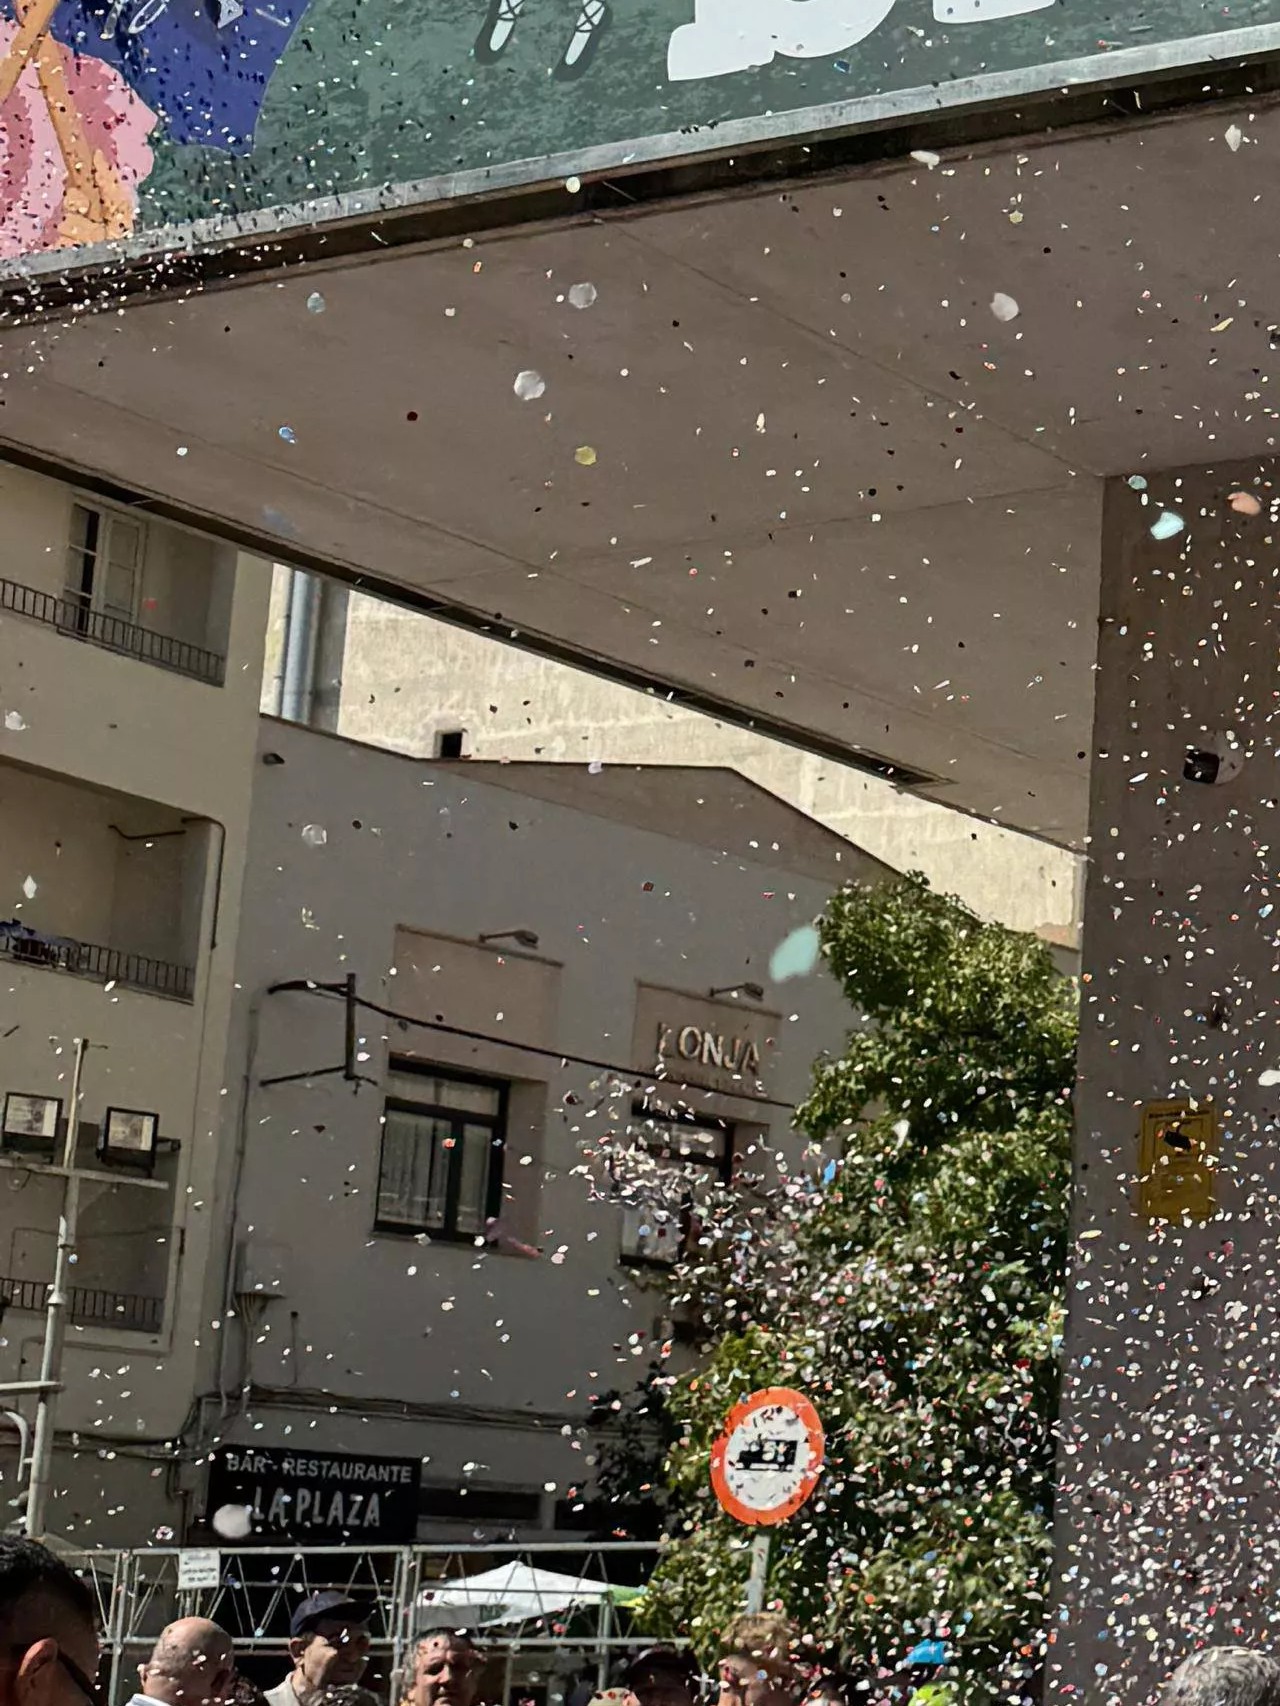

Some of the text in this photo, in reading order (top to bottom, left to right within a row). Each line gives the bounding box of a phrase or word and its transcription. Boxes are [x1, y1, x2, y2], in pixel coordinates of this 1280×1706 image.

[657, 1021, 760, 1076] LONJA
[226, 1454, 266, 1473] BAR
[282, 1458, 413, 1483] RESTAURANTE
[252, 1486, 381, 1528] LA PLAZA
